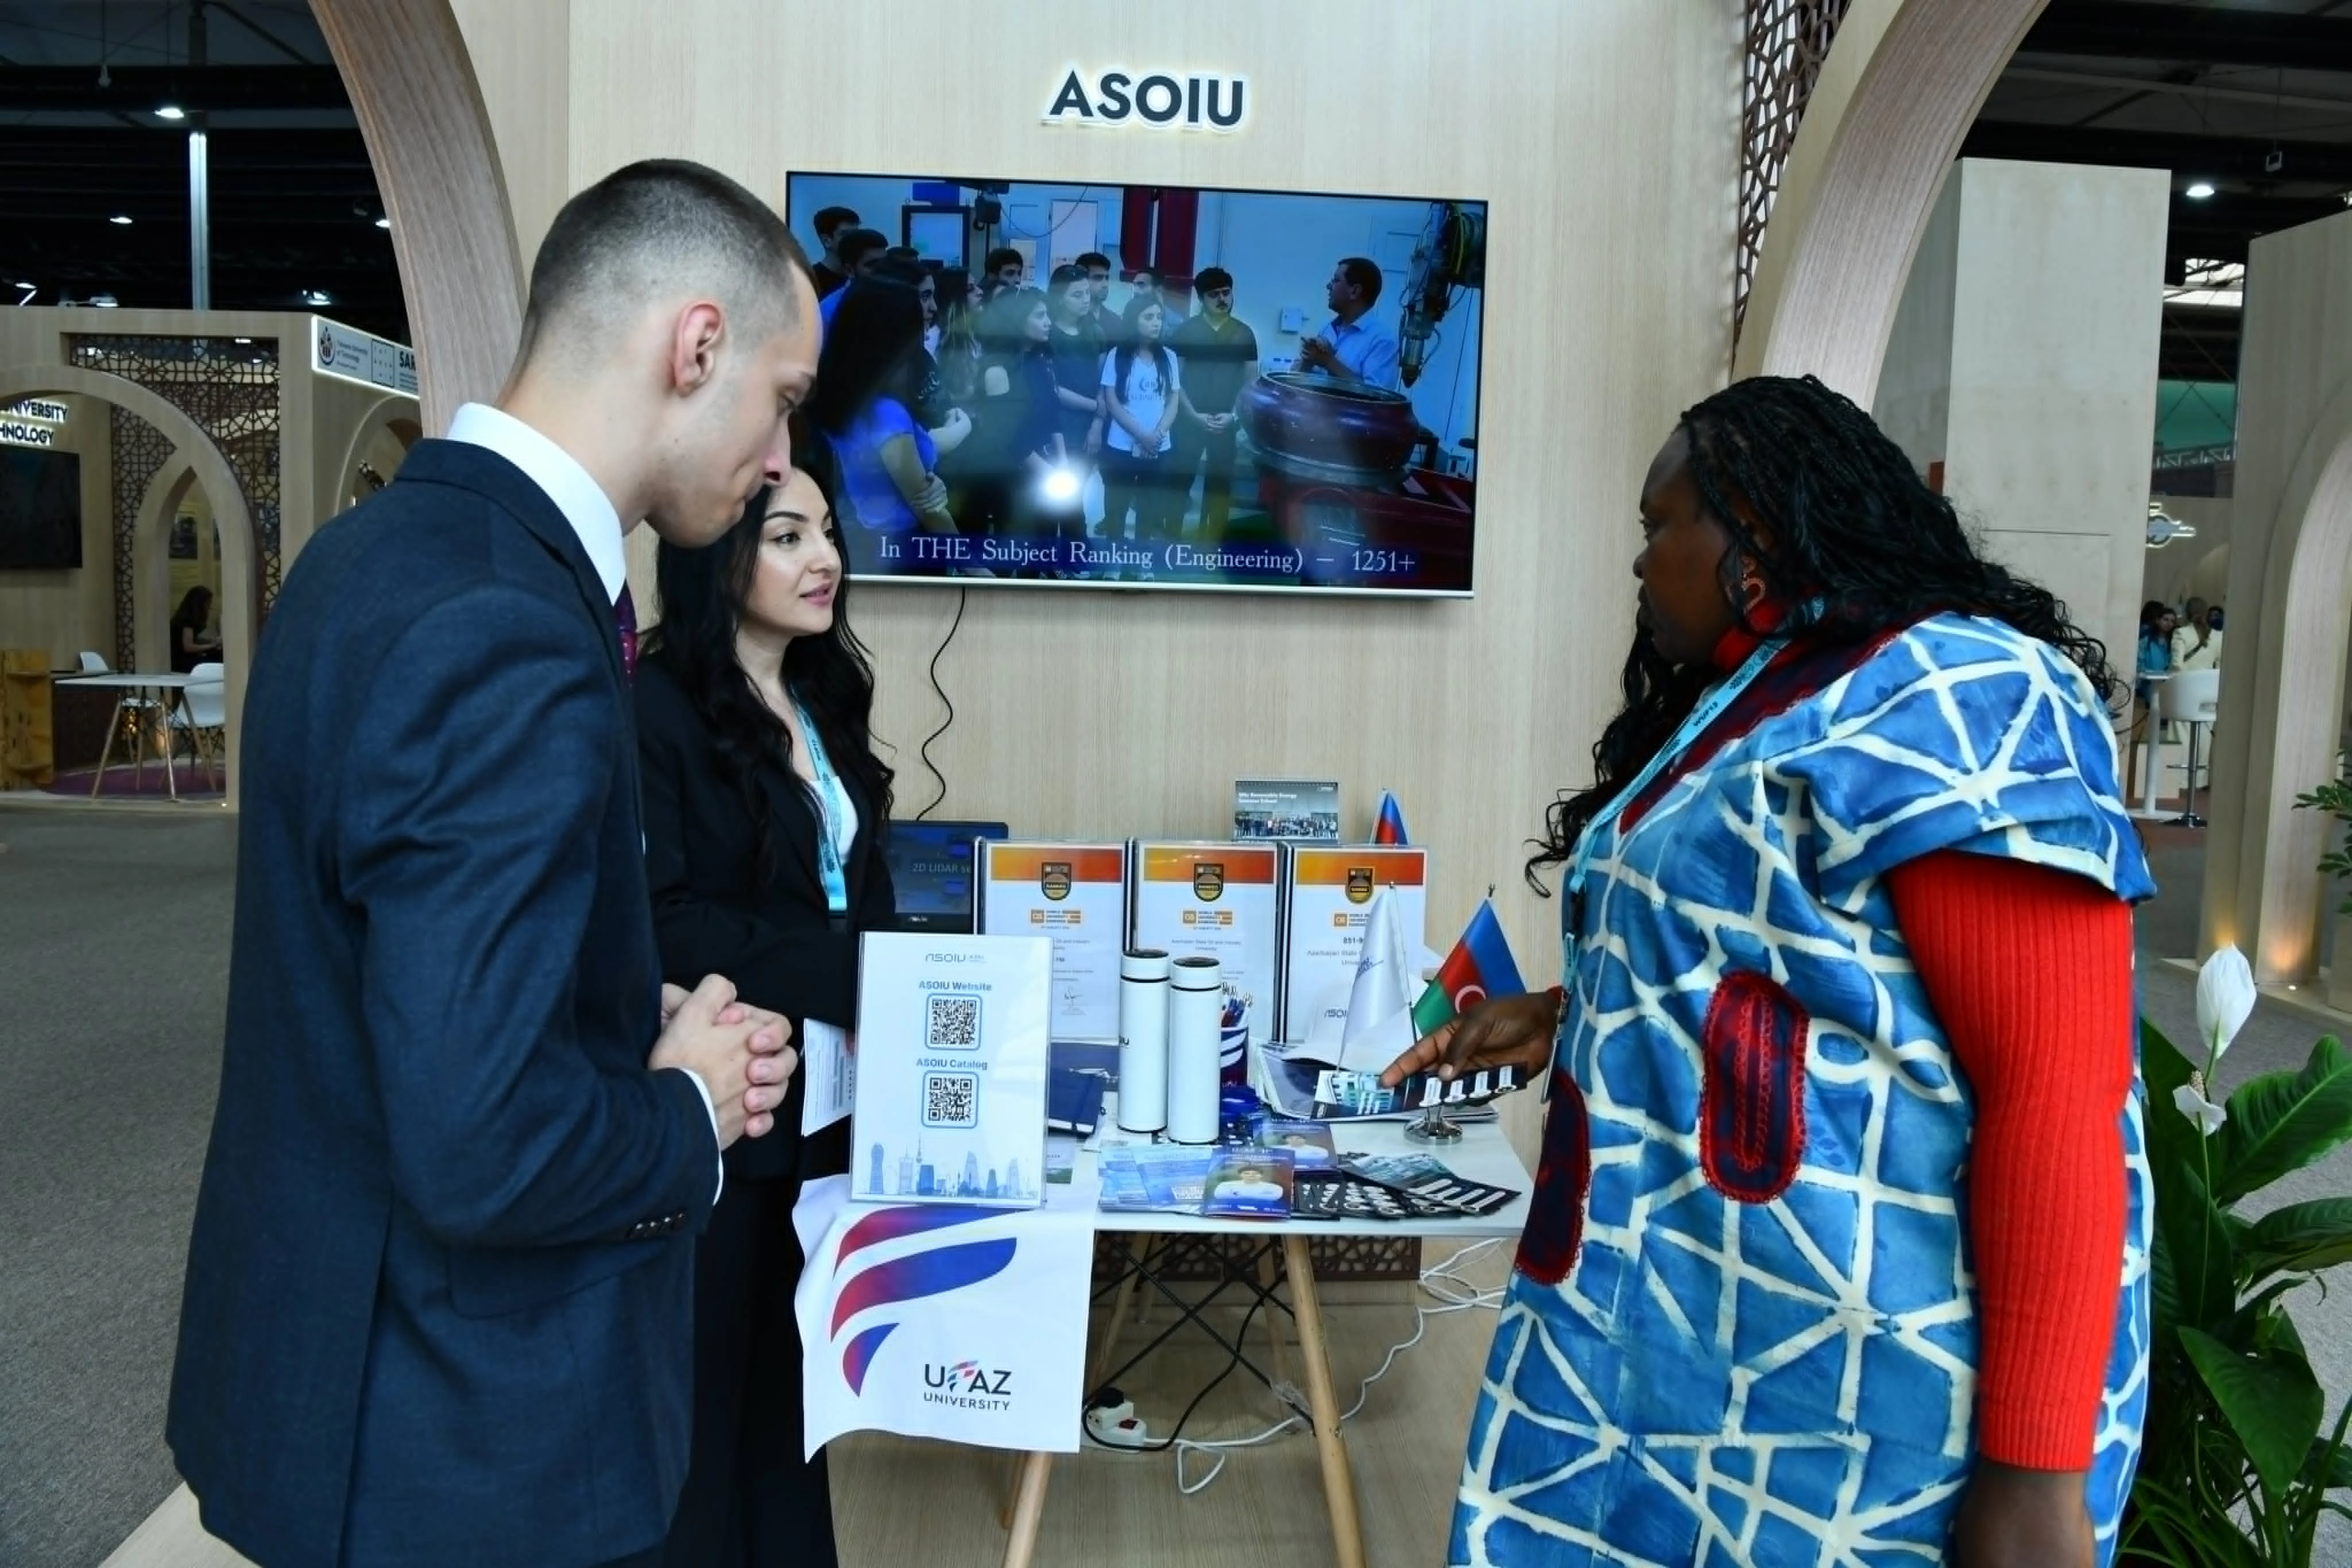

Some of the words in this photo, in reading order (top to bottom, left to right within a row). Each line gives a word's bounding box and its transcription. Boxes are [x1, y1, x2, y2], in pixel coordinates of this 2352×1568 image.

[1049, 69, 1244, 126] ASOIU
[0, 401, 68, 421] NIVERSITY
[881, 536, 901, 558] In
[911, 537, 971, 560] THE
[982, 539, 1058, 566] Subject
[1070, 541, 1153, 569] Ranking
[1165, 543, 1303, 574] (Engineering)
[1352, 550, 1415, 572] 1251+
[925, 953, 965, 962] ASOIU
[919, 981, 950, 990] ASOIU
[952, 982, 992, 991] Website
[916, 1058, 947, 1067] ASOIU
[950, 1059, 988, 1071] Catalog
[924, 1361, 1012, 1396] UFAZ
[923, 1391, 1011, 1411] UNIVERSITY
